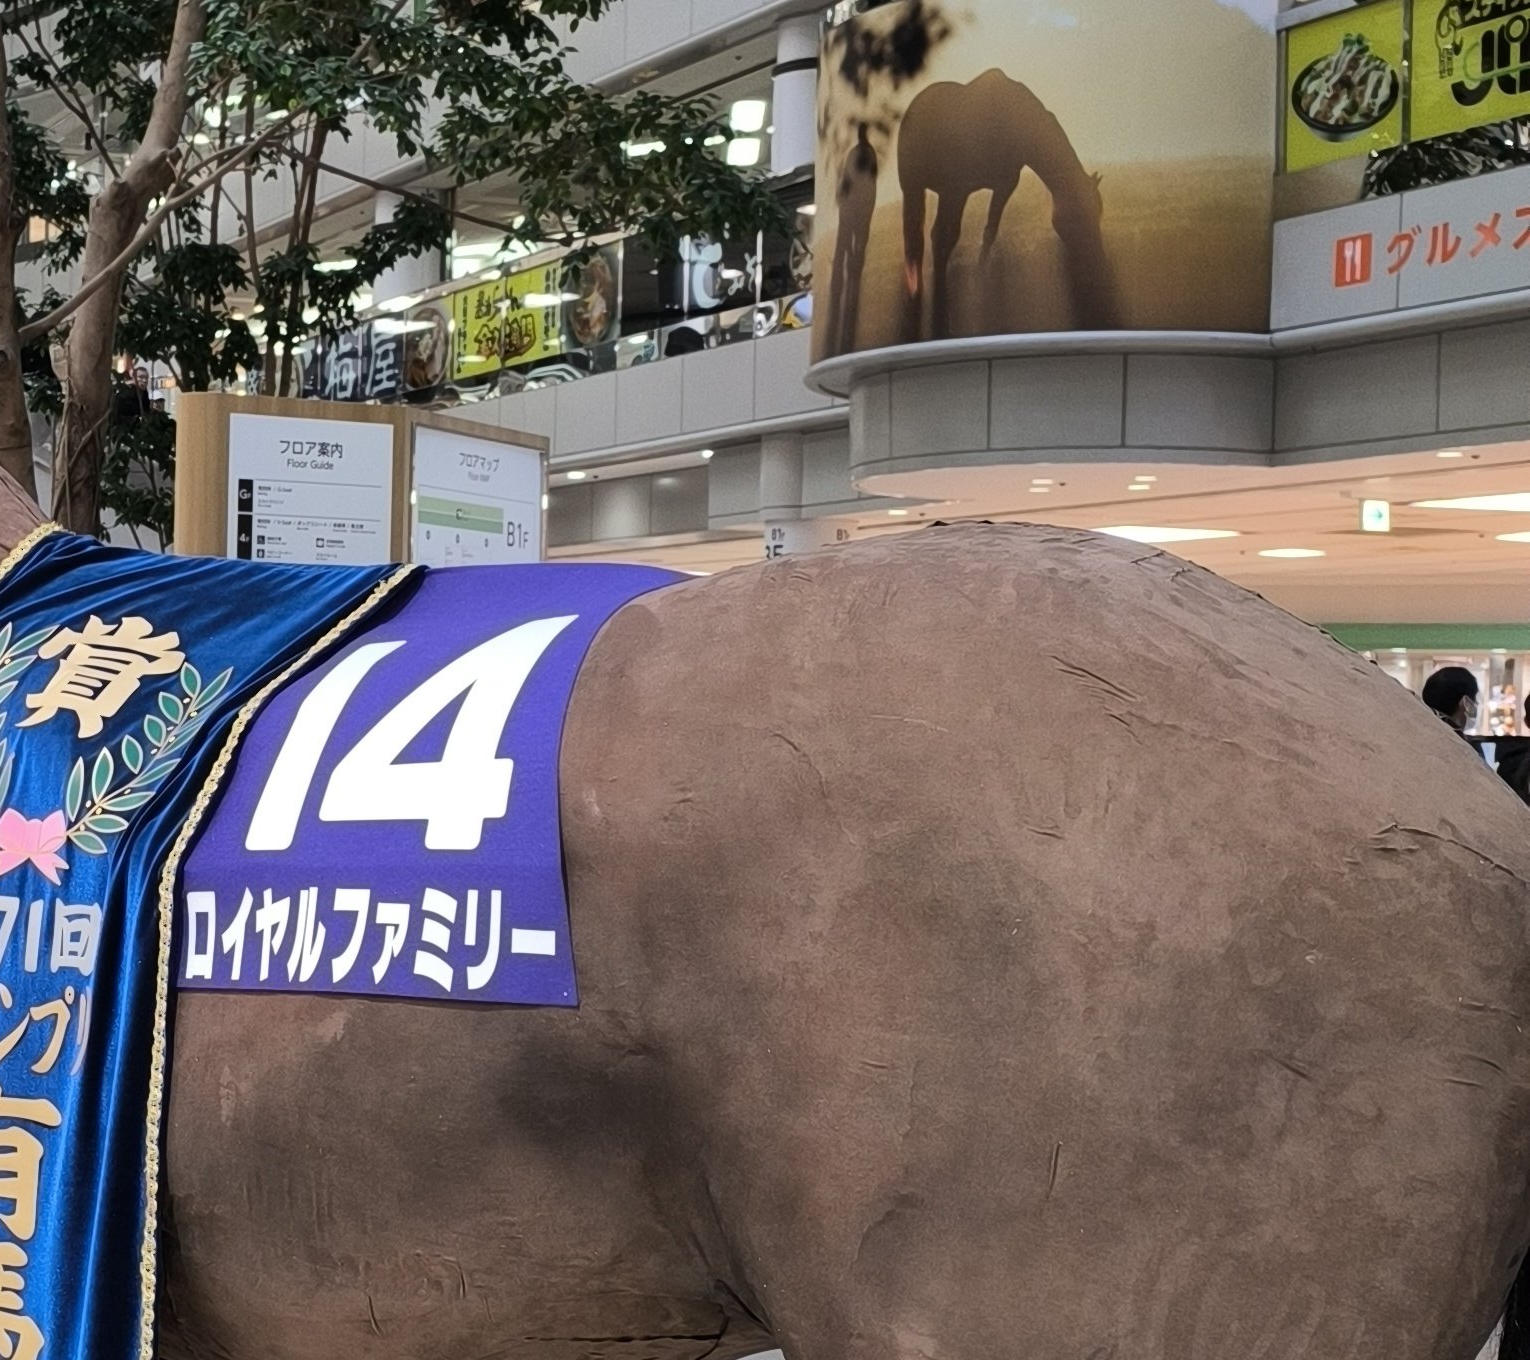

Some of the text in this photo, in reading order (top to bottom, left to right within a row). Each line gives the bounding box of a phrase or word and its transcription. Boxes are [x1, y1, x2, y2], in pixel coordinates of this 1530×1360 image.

[279, 440, 343, 459] フロア案内
[459, 452, 500, 473] フロアマップ
[287, 458, 334, 471] Floor Guide
[506, 521, 530, 550] B1F
[15, 614, 186, 738] 賞
[245, 614, 580, 851] 14
[185, 886, 557, 993] ロイヤルファミリー
